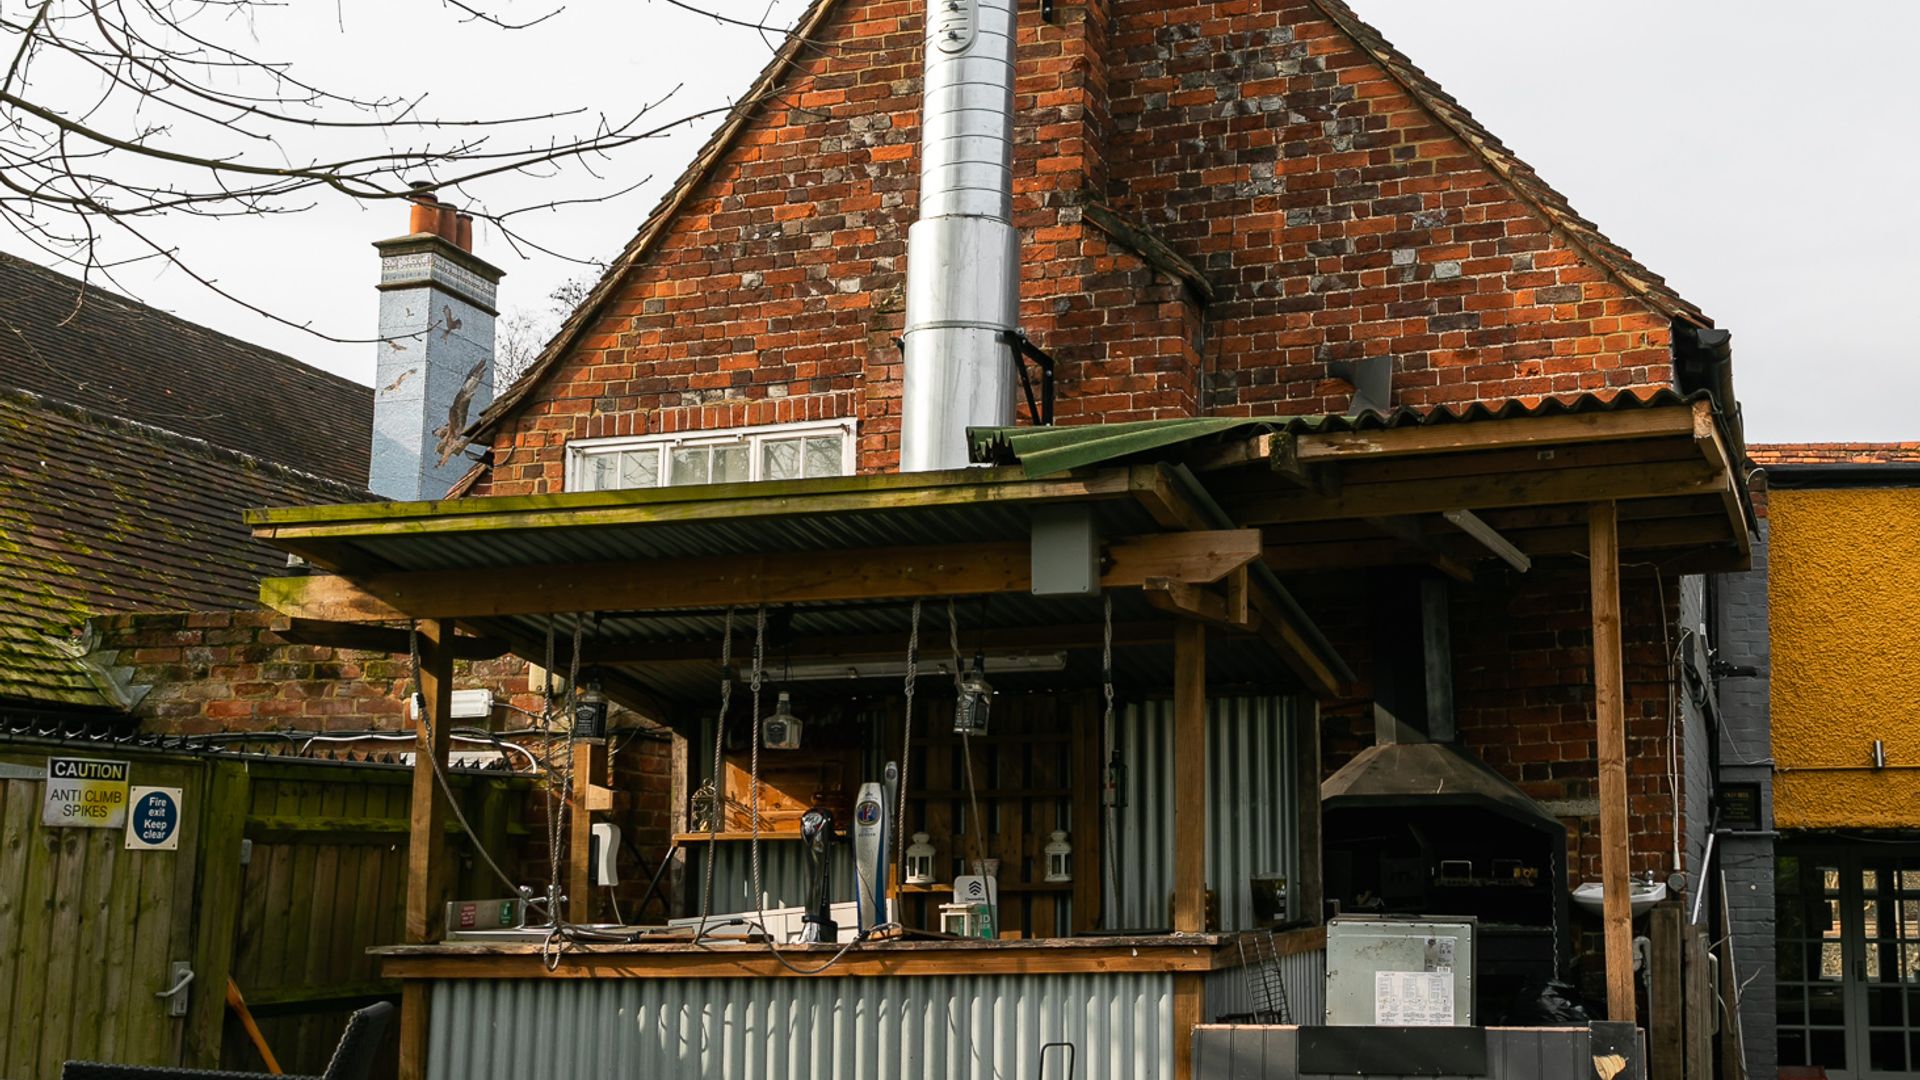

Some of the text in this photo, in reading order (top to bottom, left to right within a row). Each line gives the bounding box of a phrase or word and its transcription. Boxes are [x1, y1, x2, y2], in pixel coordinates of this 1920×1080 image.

[55, 762, 123, 779] CAUTION
[50, 789, 122, 803] ANTI CLIMB
[149, 797, 167, 807] Fire
[63, 804, 108, 817] SPIKES
[148, 808, 166, 817] exit
[144, 819, 167, 830] Keep
[143, 829, 166, 839] clear
